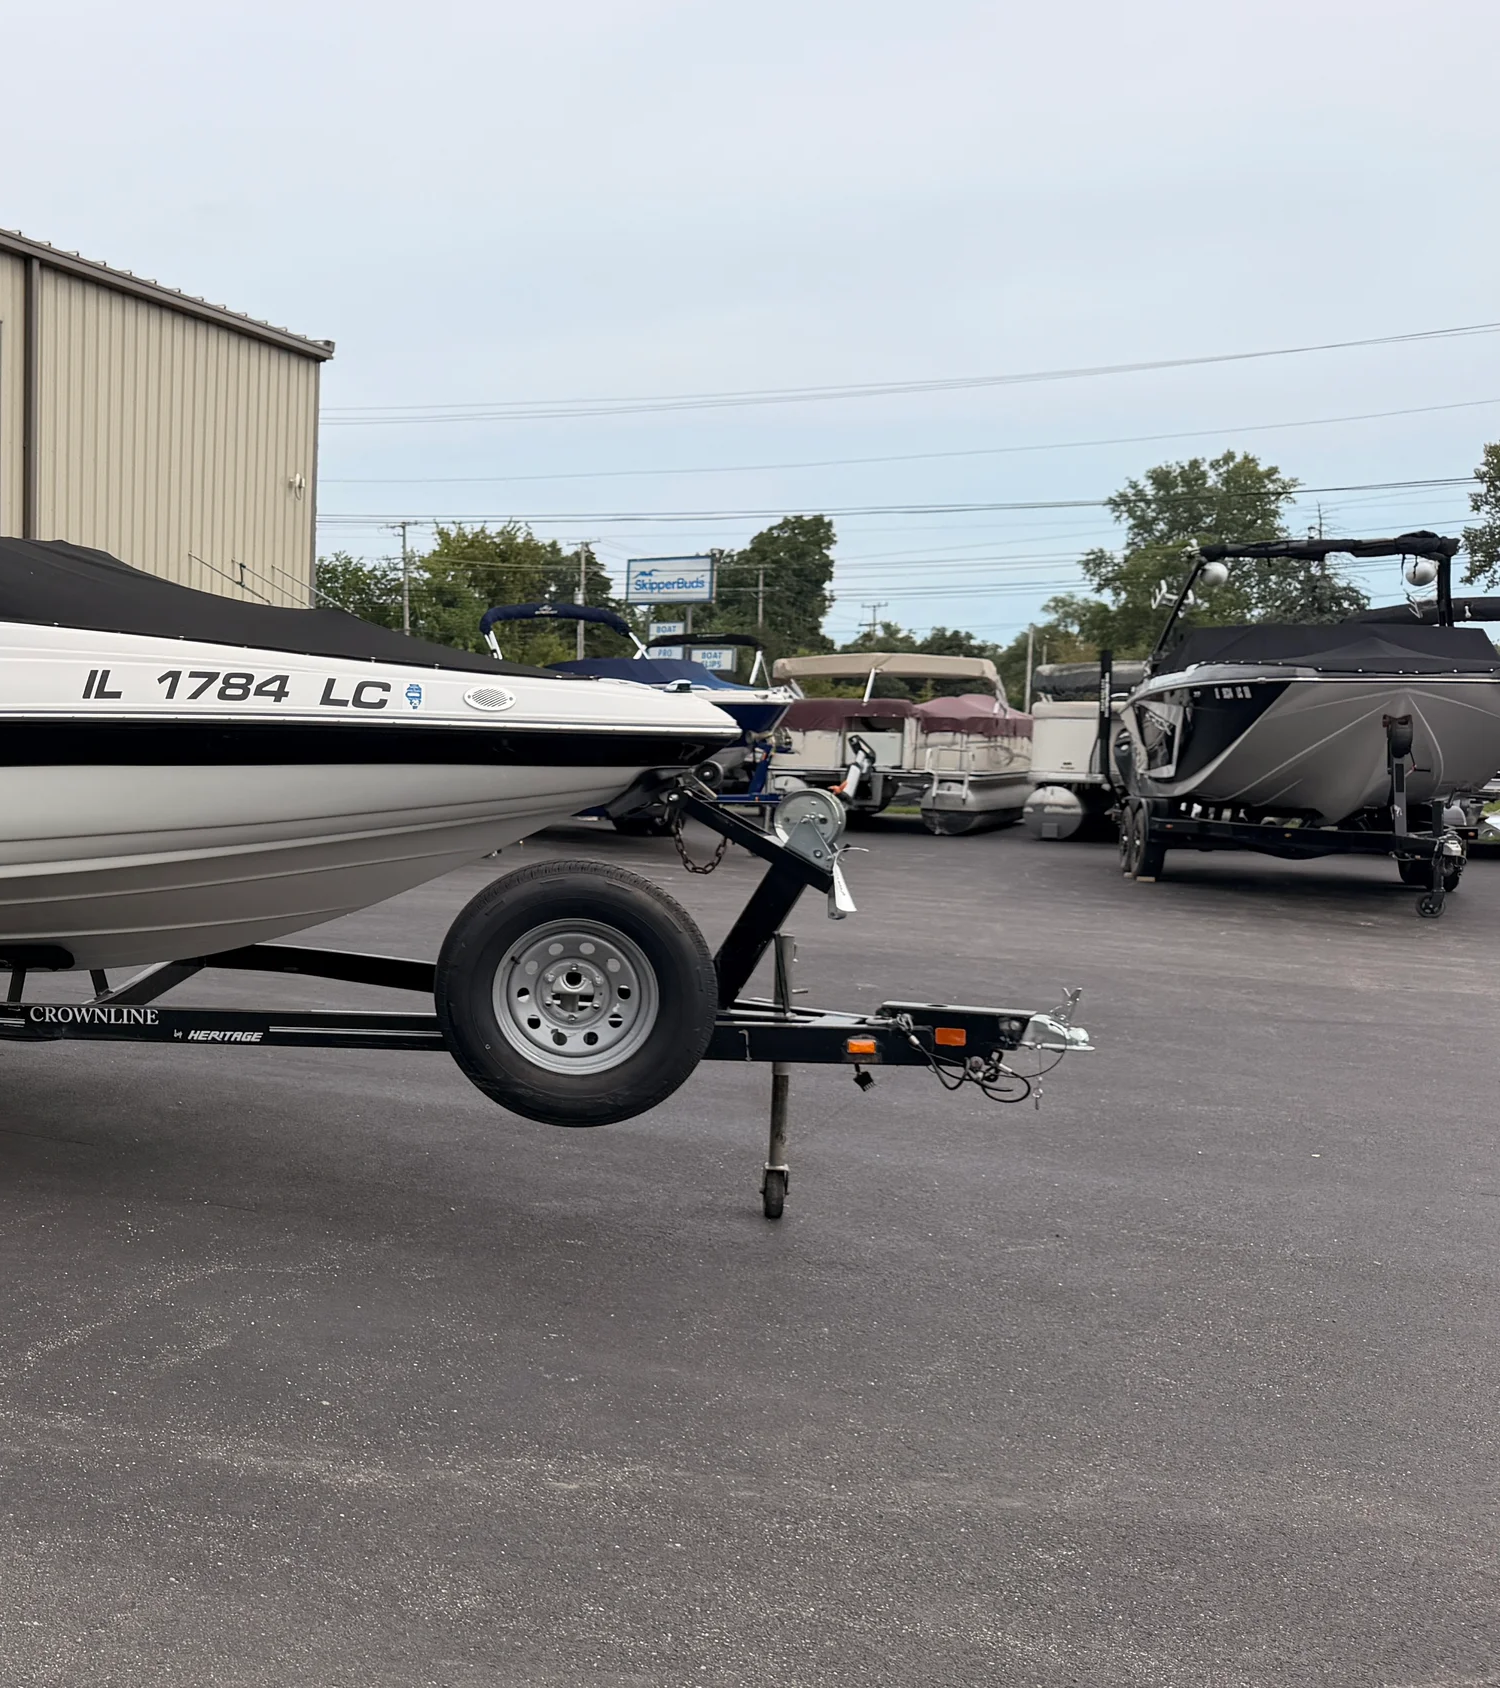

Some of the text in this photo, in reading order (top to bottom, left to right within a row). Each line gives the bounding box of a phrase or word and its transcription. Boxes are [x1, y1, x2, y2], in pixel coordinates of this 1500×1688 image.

[656, 625, 677, 633] BOAT
[657, 649, 673, 657] PRO
[701, 651, 723, 659] BOAT
[82, 669, 123, 699] IL
[156, 670, 290, 703] 1784
[319, 677, 392, 710] LC
[29, 1006, 160, 1025] CROWNLINE
[187, 1030, 264, 1042] HERITAGE
